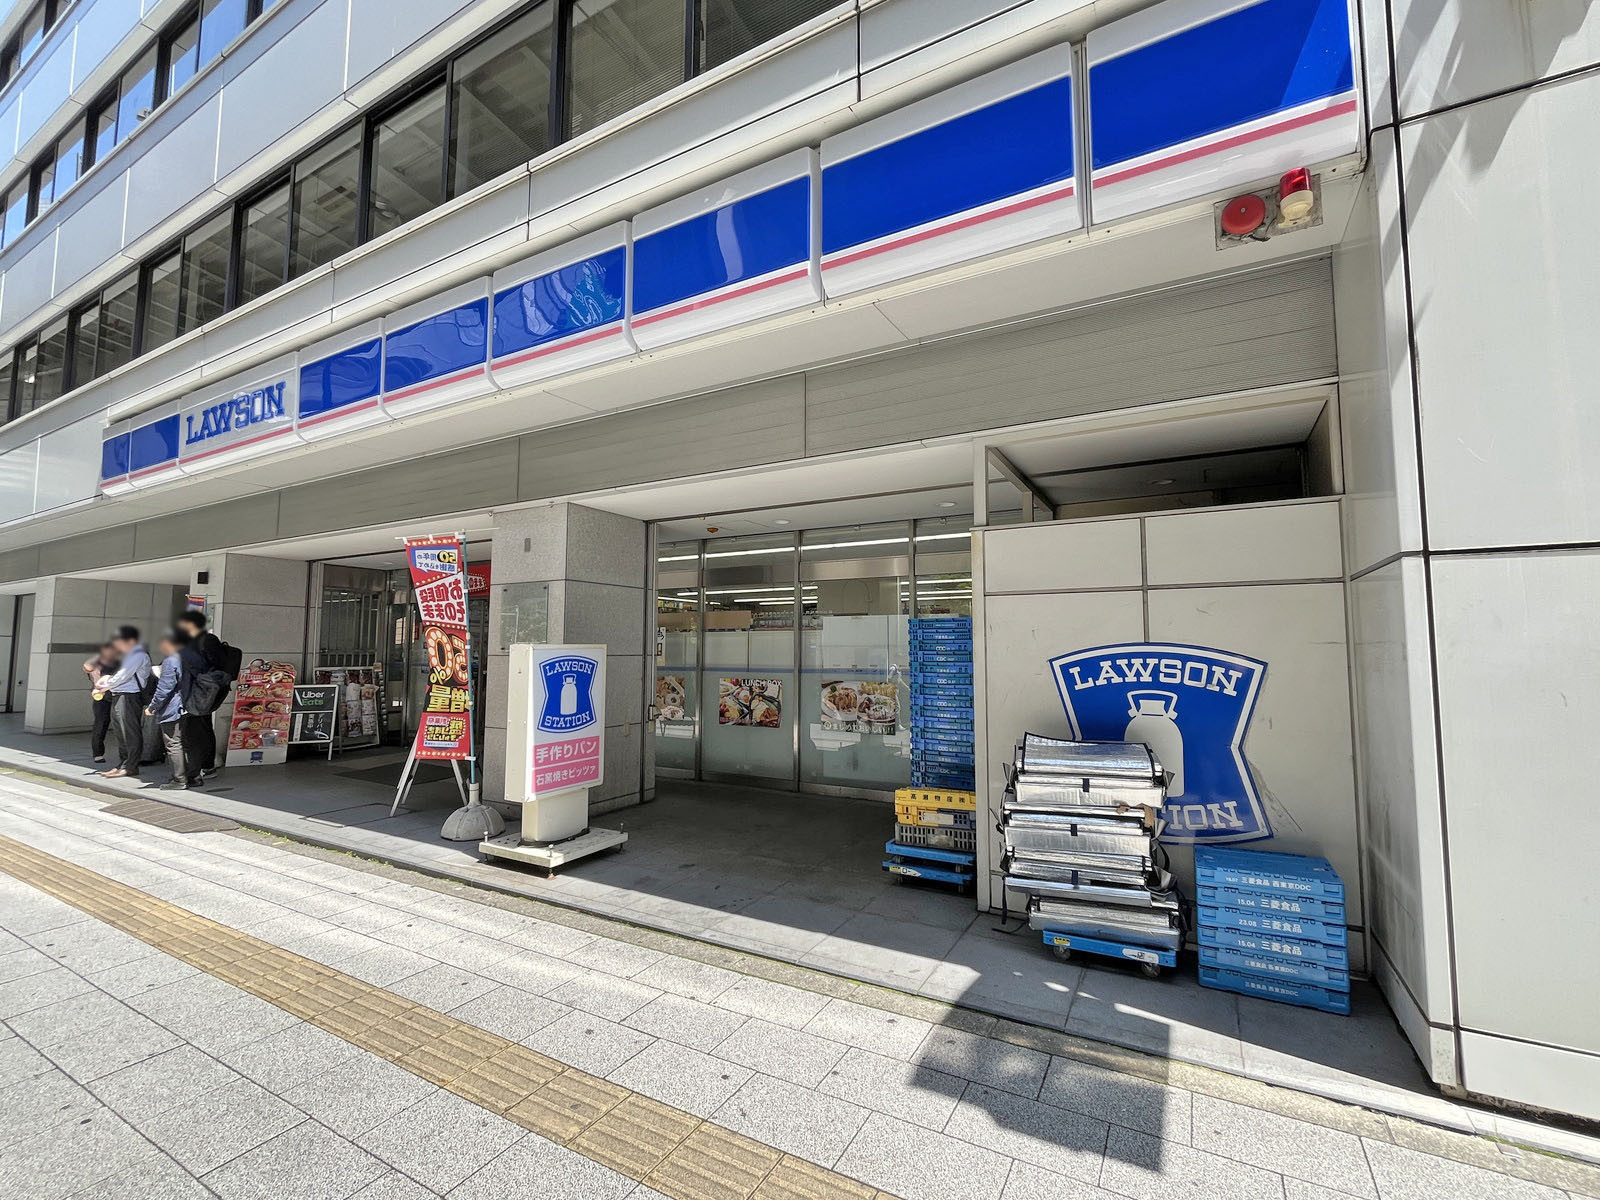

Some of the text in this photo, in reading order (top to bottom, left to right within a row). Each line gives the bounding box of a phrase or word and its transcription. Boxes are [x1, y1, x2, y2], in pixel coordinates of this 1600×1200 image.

[186, 381, 287, 445] LAWSON
[546, 660, 592, 677] LAWSON
[1069, 658, 1243, 696] LAWSON
[544, 710, 591, 728] STATION
[535, 740, 597, 763] 手作りパン
[535, 764, 596, 786] 石窯焼きピッツァ
[1261, 899, 1301, 912] 三菱食品
[1262, 919, 1302, 934] 三菱食品
[1261, 940, 1302, 956] 三菱食品
